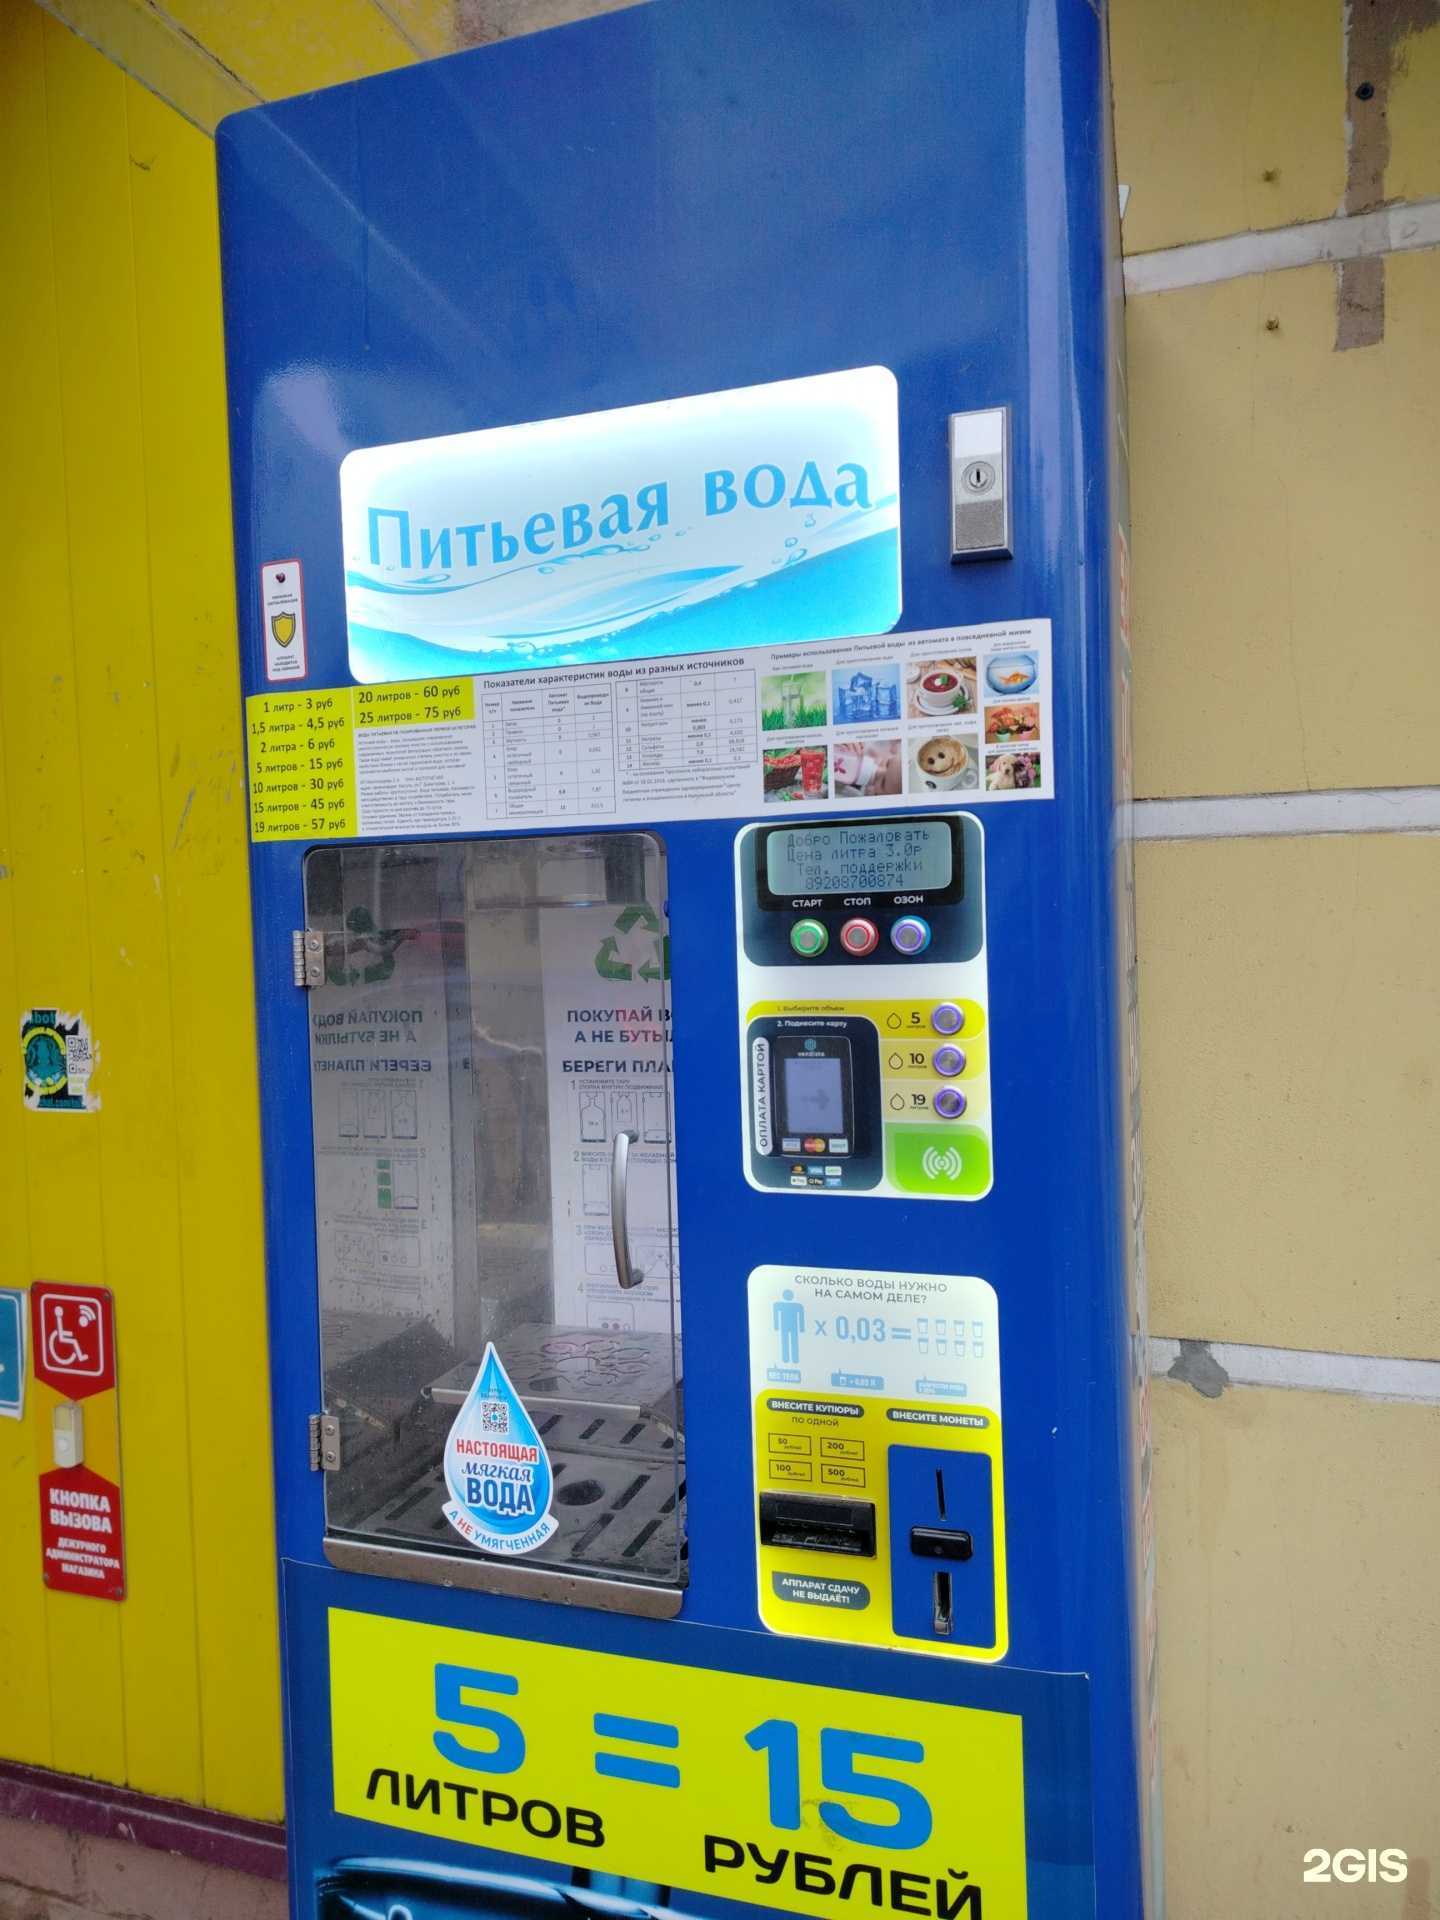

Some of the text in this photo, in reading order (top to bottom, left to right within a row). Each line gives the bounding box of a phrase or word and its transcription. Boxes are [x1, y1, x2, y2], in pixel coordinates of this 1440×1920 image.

[367, 461, 874, 569] Питьевая вода
[484, 658, 745, 689] Показатели характеристик воды из разных источников
[359, 691, 373, 704] 20
[376, 691, 411, 703] литров
[424, 686, 438, 698] 60
[442, 686, 460, 698] руб
[264, 702, 269, 713] 1
[273, 703, 294, 713] литр
[306, 699, 312, 709] 3
[316, 699, 333, 711] руб
[360, 712, 374, 724] 25
[377, 712, 412, 723] литров
[424, 706, 439, 719] 75
[443, 706, 461, 719] руб
[252, 723, 265, 736] 1,5
[269, 723, 295, 734] литра
[307, 718, 324, 731] 4,5
[328, 718, 345, 731] руб
[261, 742, 266, 753] 2
[270, 743, 296, 753] литра
[308, 738, 315, 749] 6
[318, 738, 335, 750] руб
[257, 763, 262, 773] 5
[265, 763, 297, 773] литров
[310, 759, 323, 769] 15
[327, 759, 343, 771] руб
[253, 783, 263, 794] 10
[265, 783, 298, 793] литров
[310, 779, 324, 790] 30
[327, 779, 344, 791] руб
[254, 803, 264, 814] 15
[267, 803, 299, 813] литров
[311, 799, 324, 810] 45
[328, 799, 345, 811] руб
[255, 822, 265, 833] 19
[267, 822, 300, 833] литров
[312, 819, 325, 830] 57
[329, 819, 346, 831] руб
[787, 831, 929, 848] Добро Пожаловать
[788, 848, 822, 862] Цена
[832, 848, 876, 860] литра
[799, 858, 922, 876] Тел. поддержки
[792, 895, 923, 908] СТАРТ СТОП ОЗОН
[567, 1007, 652, 1022] ПОКУПАЙ
[911, 1012, 920, 1024] 5
[785, 1020, 824, 1028] Поднесите
[575, 1030, 672, 1042] А НЕ БУТЫ
[563, 1060, 673, 1072] БЕРЕГИ ПЛА
[910, 1053, 925, 1064] 10
[756, 1043, 768, 1147] ОПЛАТА КАРТОЙ
[912, 1094, 926, 1105] 19
[795, 1275, 948, 1293] СКОЛЬКО ВОДЫ НУЖНО
[815, 1289, 928, 1304] НА САМОМ ДЕЛЕ?
[836, 1315, 886, 1344] 0,03
[772, 1400, 859, 1416] ВНЕСИТЕ КУПЮРЫ
[792, 1416, 839, 1428] ПО ОДНОЙ
[892, 1410, 984, 1427] ВНЕСИТЕ МОНЕТЫ
[456, 1439, 538, 1463] НАСТОЯЩАЯ
[827, 1442, 844, 1450] 200
[461, 1461, 532, 1482] мягкая
[50, 1488, 111, 1512] КНОПКА
[467, 1477, 534, 1515] ВОДА
[50, 1508, 112, 1533] ВЫЗОВА
[449, 1509, 551, 1551] А НЕ УМЯГЧЕННАЯ
[46, 1548, 120, 1569] АДМИНИСТРАТОРА
[782, 1577, 860, 1595] АППАРАТ СДАЧУ
[792, 1590, 850, 1605] НЕ ВЫДАЁТ!
[433, 1662, 526, 1775] 5
[744, 1719, 933, 1850] 15
[365, 1768, 983, 1919] ЛИТРОВ РУБЛЕЙ
